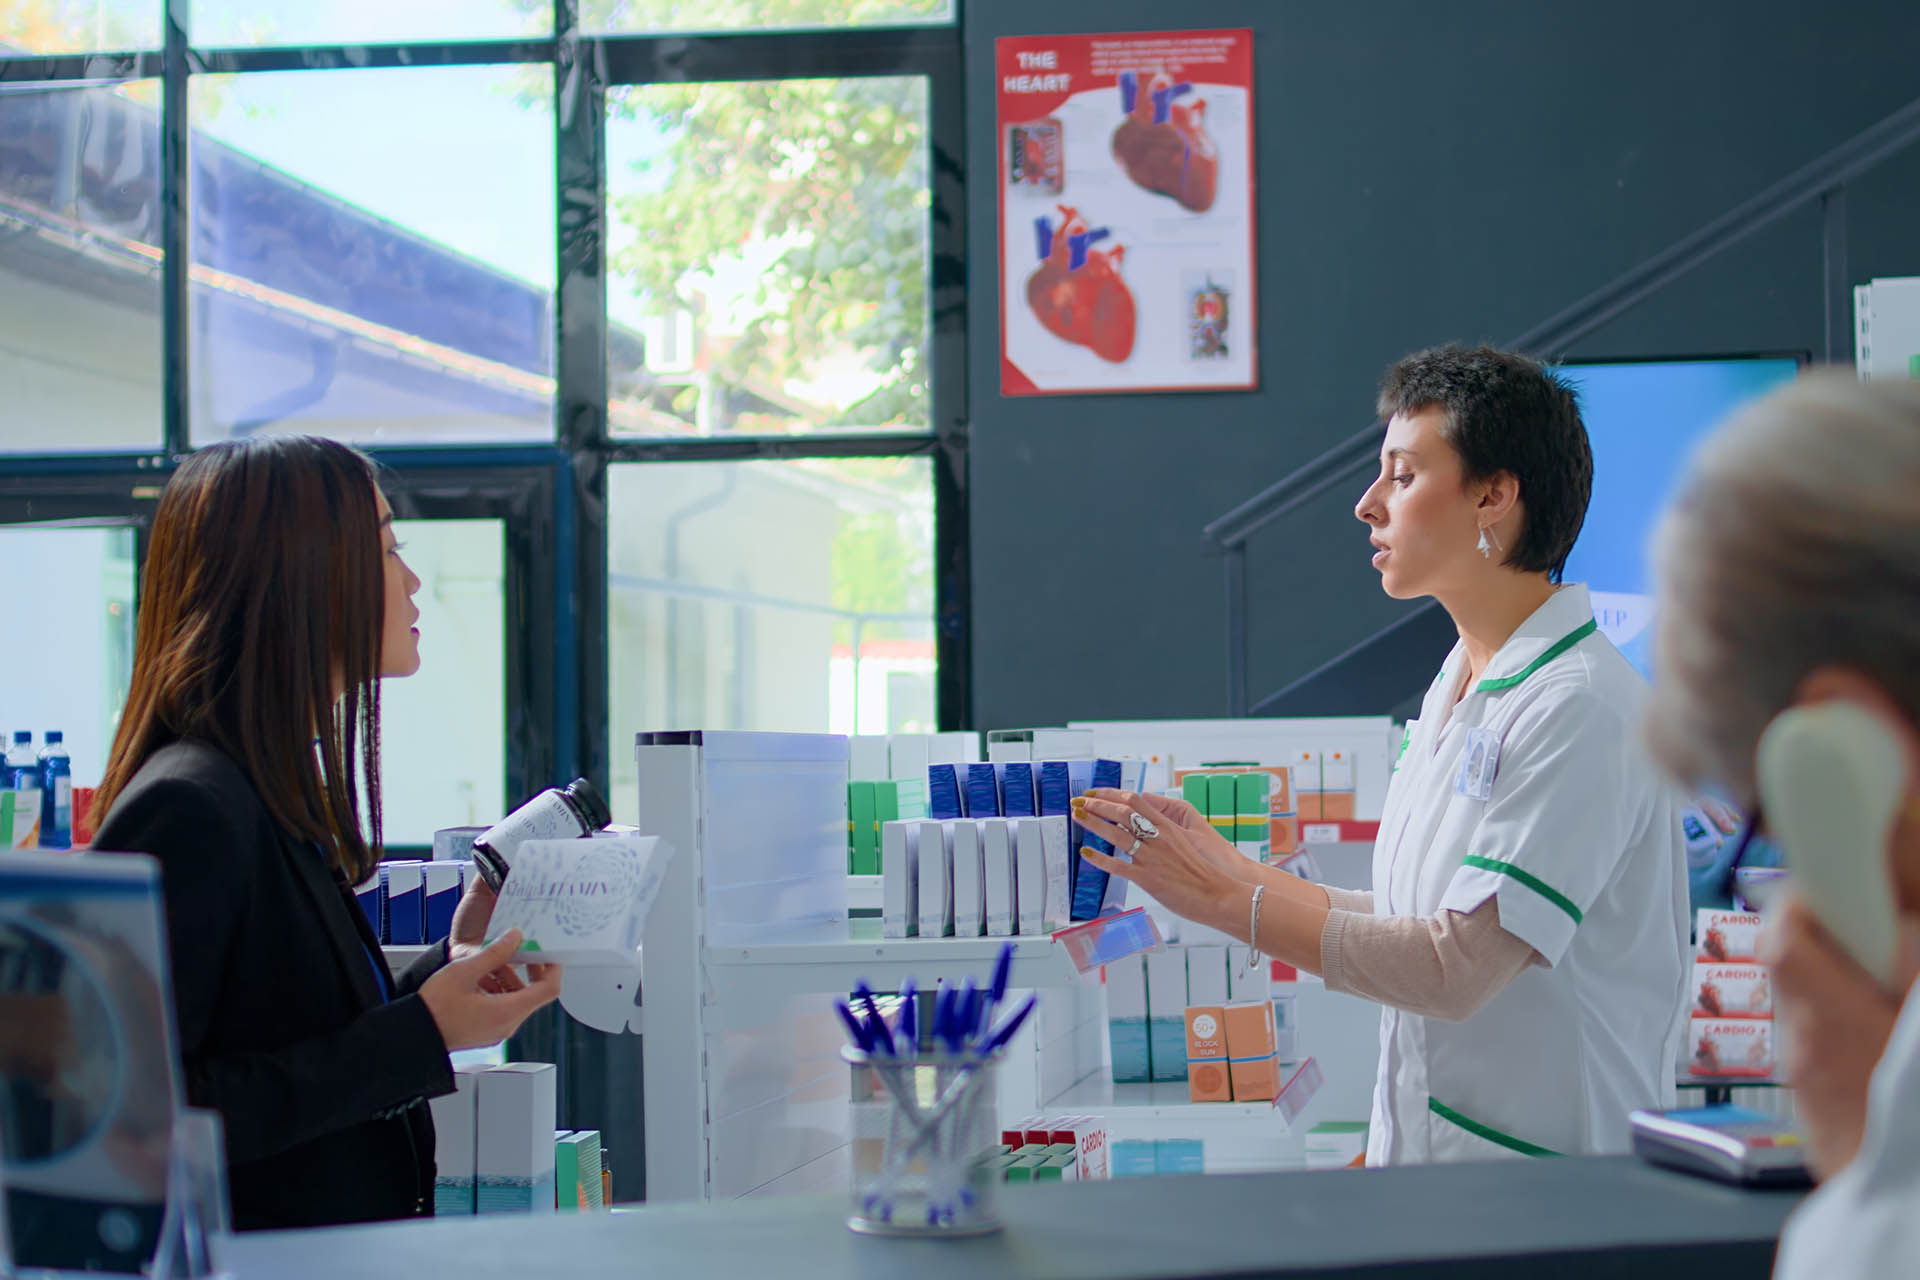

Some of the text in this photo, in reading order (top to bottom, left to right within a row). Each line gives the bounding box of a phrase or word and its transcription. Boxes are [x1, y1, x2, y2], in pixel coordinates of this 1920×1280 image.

[1016, 51, 1057, 70] THE
[1003, 73, 1072, 93] HEART
[1711, 915, 1761, 927] CARDIO
[1706, 969, 1757, 981] CARDIO
[1194, 1023, 1215, 1033] 50+
[1703, 1024, 1757, 1036] CARDIO
[1194, 1040, 1219, 1048] BLOCK
[1200, 1048, 1216, 1056] SUN
[1081, 1129, 1103, 1155] CARDIO
